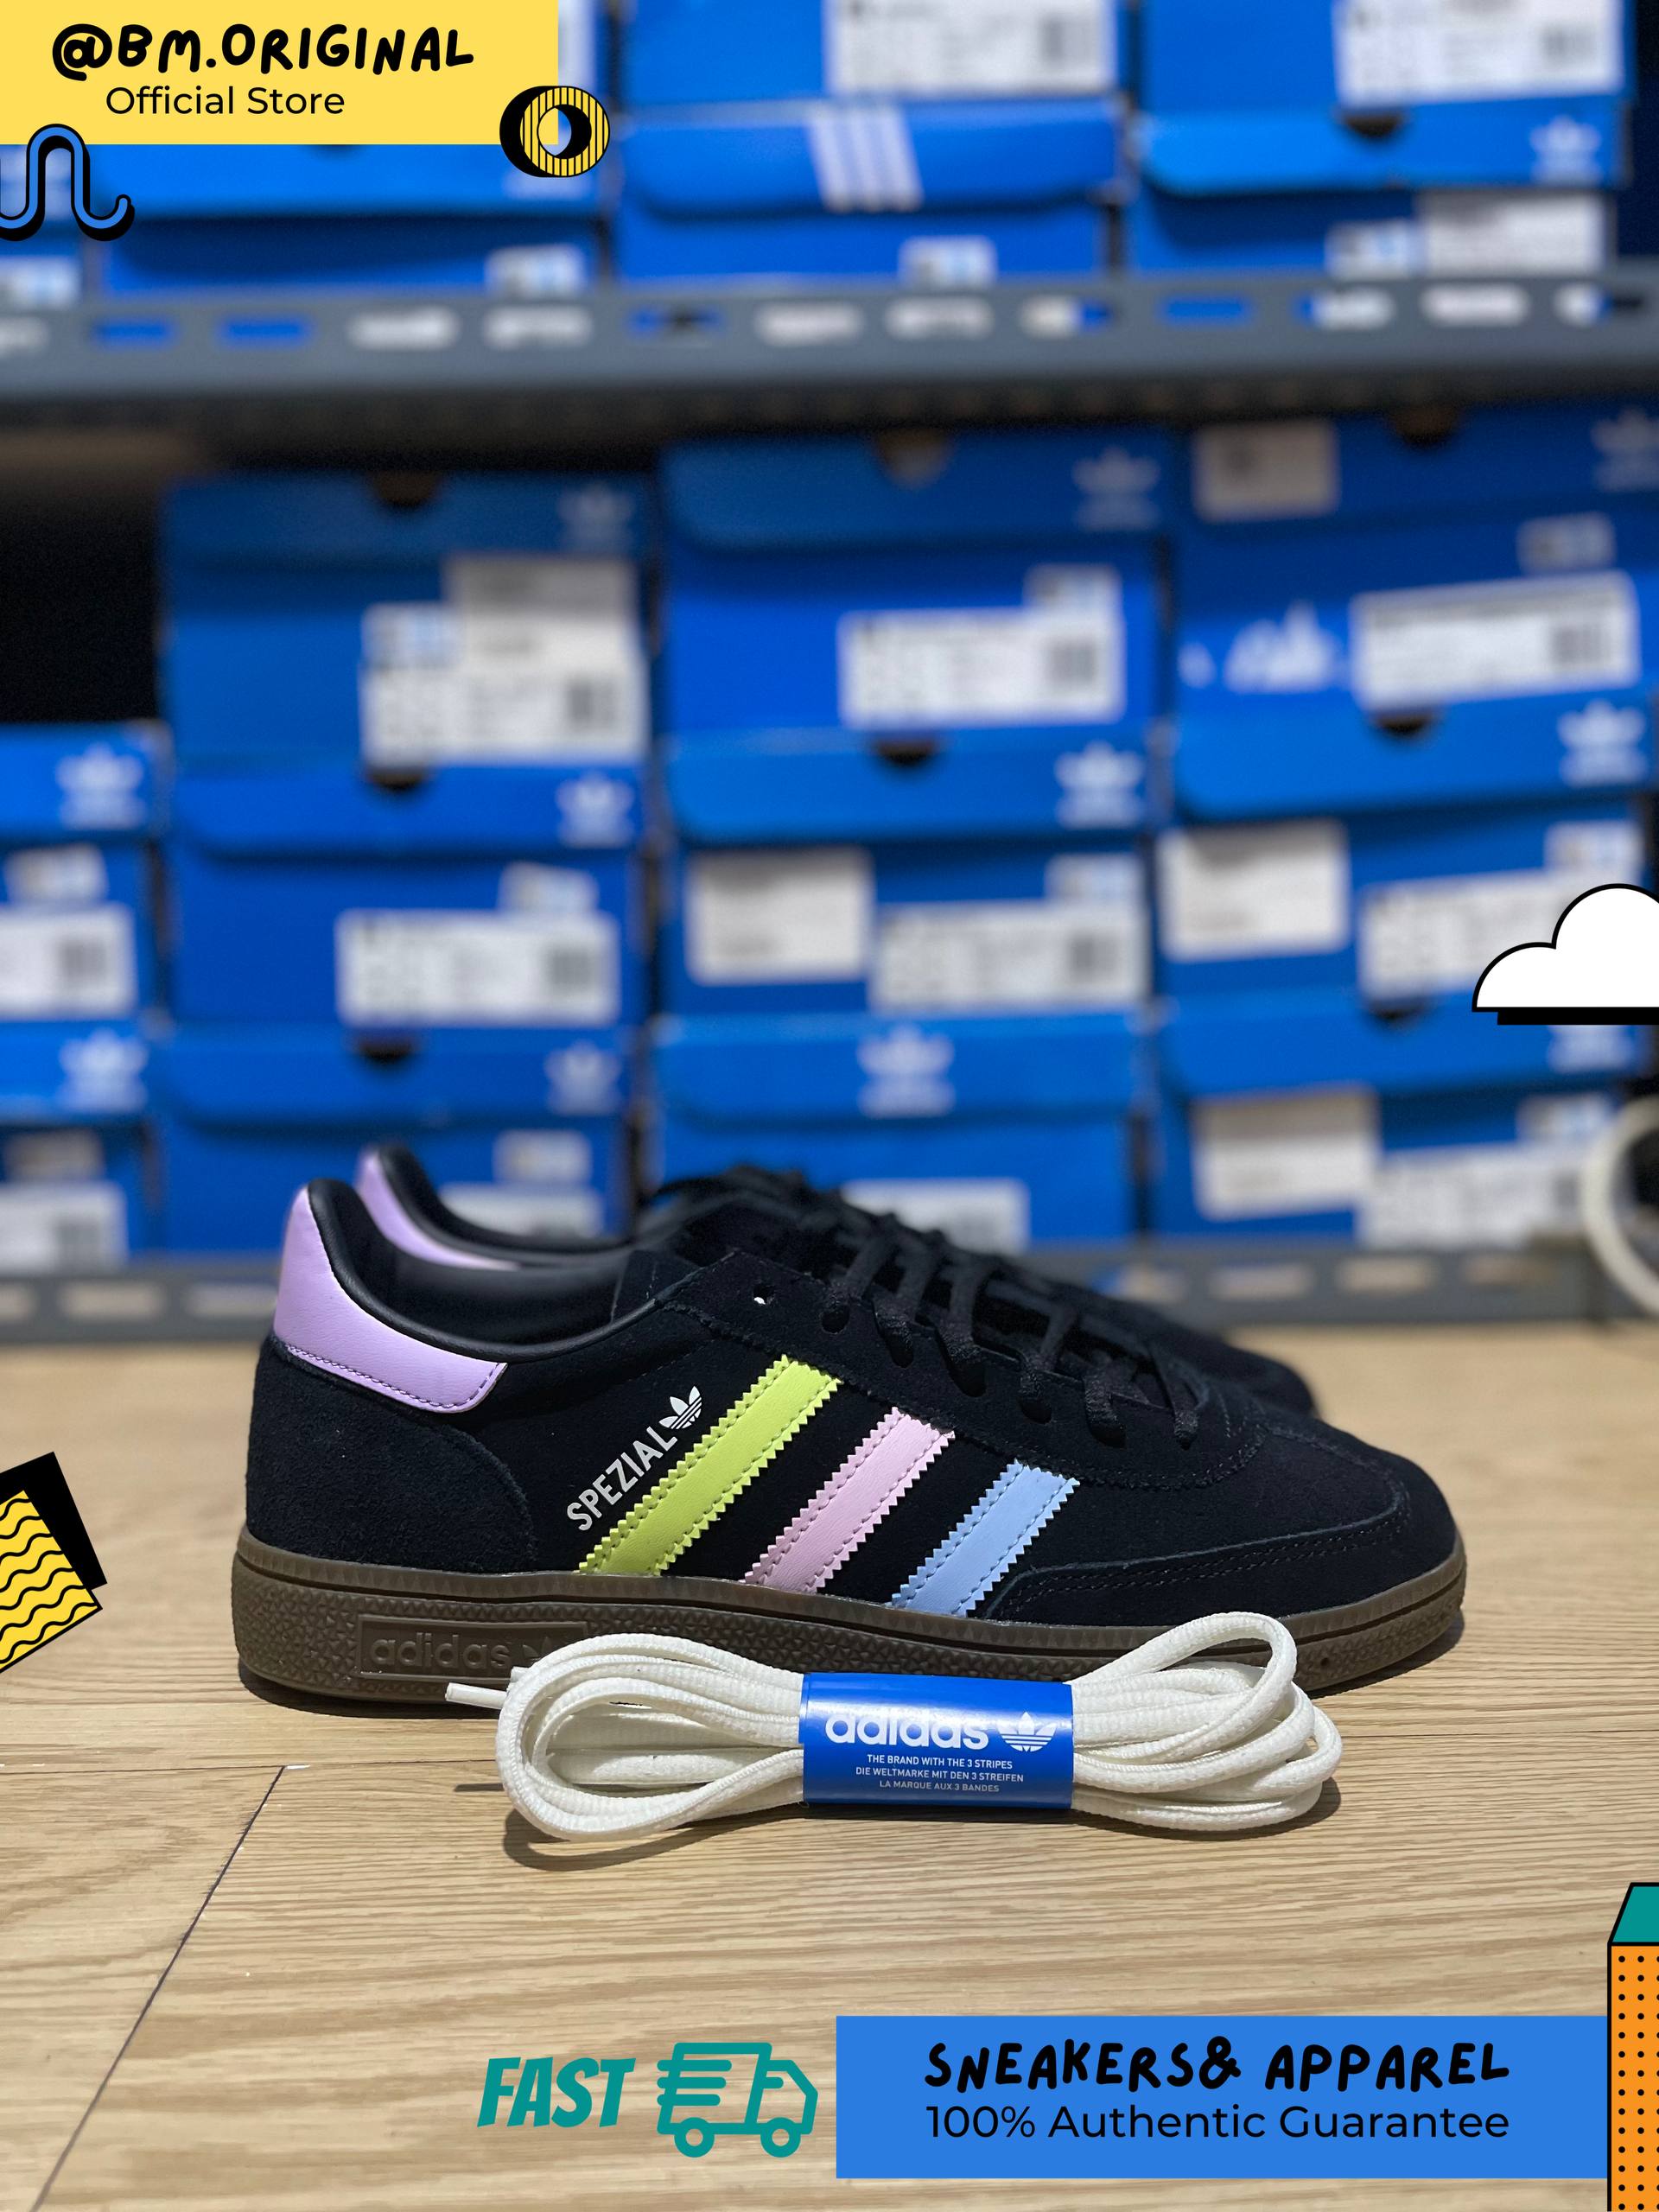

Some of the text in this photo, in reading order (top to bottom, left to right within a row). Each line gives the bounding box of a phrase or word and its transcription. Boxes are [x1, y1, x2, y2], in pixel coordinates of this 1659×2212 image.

[567, 1427, 677, 1531] SPEZIAL
[370, 1632, 512, 1670] adidas
[867, 1754, 1013, 1770] THE BRAND WITH THE 3 STRIPES
[855, 1767, 1024, 1783] DIE WELTMARKE MIT DEN 3 STREIFEN
[880, 1780, 891, 1789] LA
[893, 1781, 931, 1789] MARQUE
[962, 1783, 1000, 1792] BANDES
